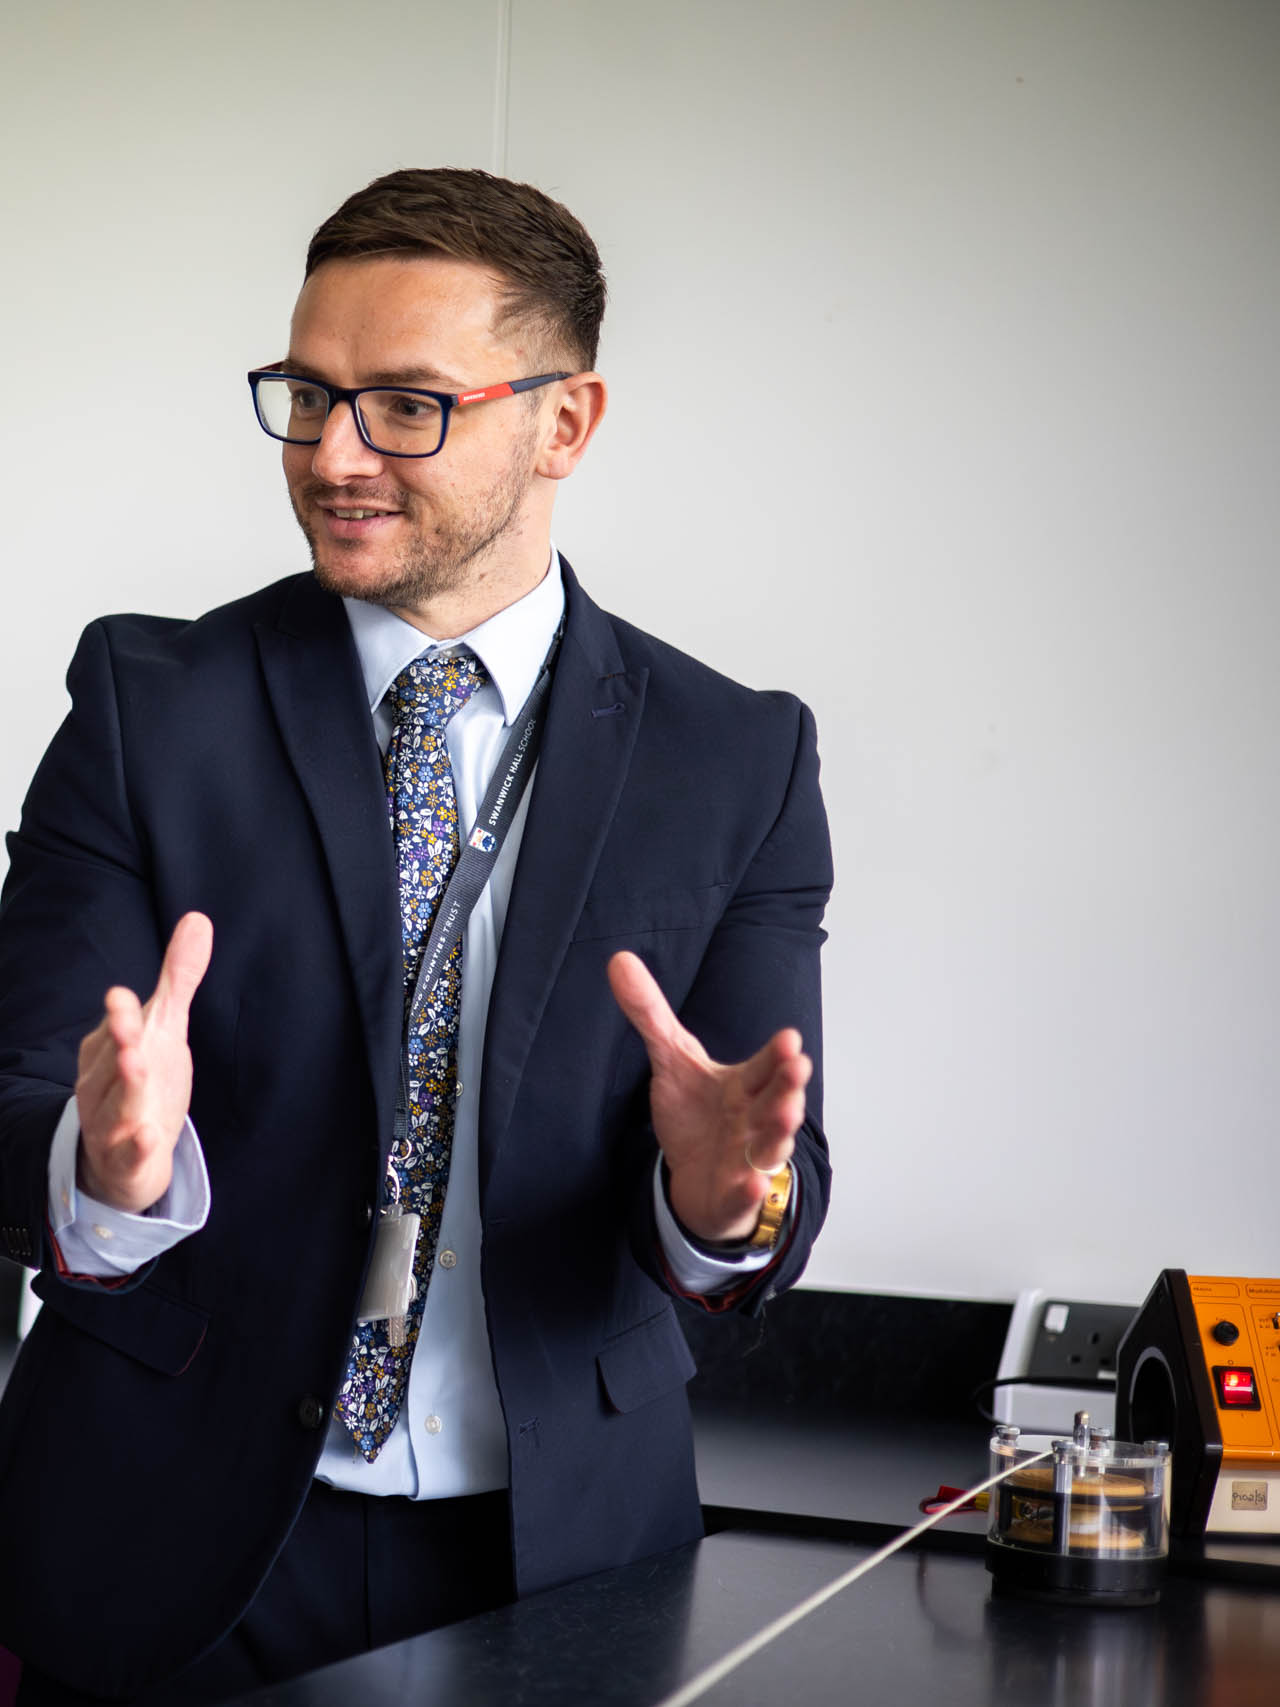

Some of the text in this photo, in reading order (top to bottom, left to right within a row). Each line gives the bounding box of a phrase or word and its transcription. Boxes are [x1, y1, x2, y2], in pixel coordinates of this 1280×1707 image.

[488, 719, 537, 826] SWANWICK HALL SCHOOL
[422, 936, 446, 990] COUNTIES
[443, 901, 461, 933] TRUST
